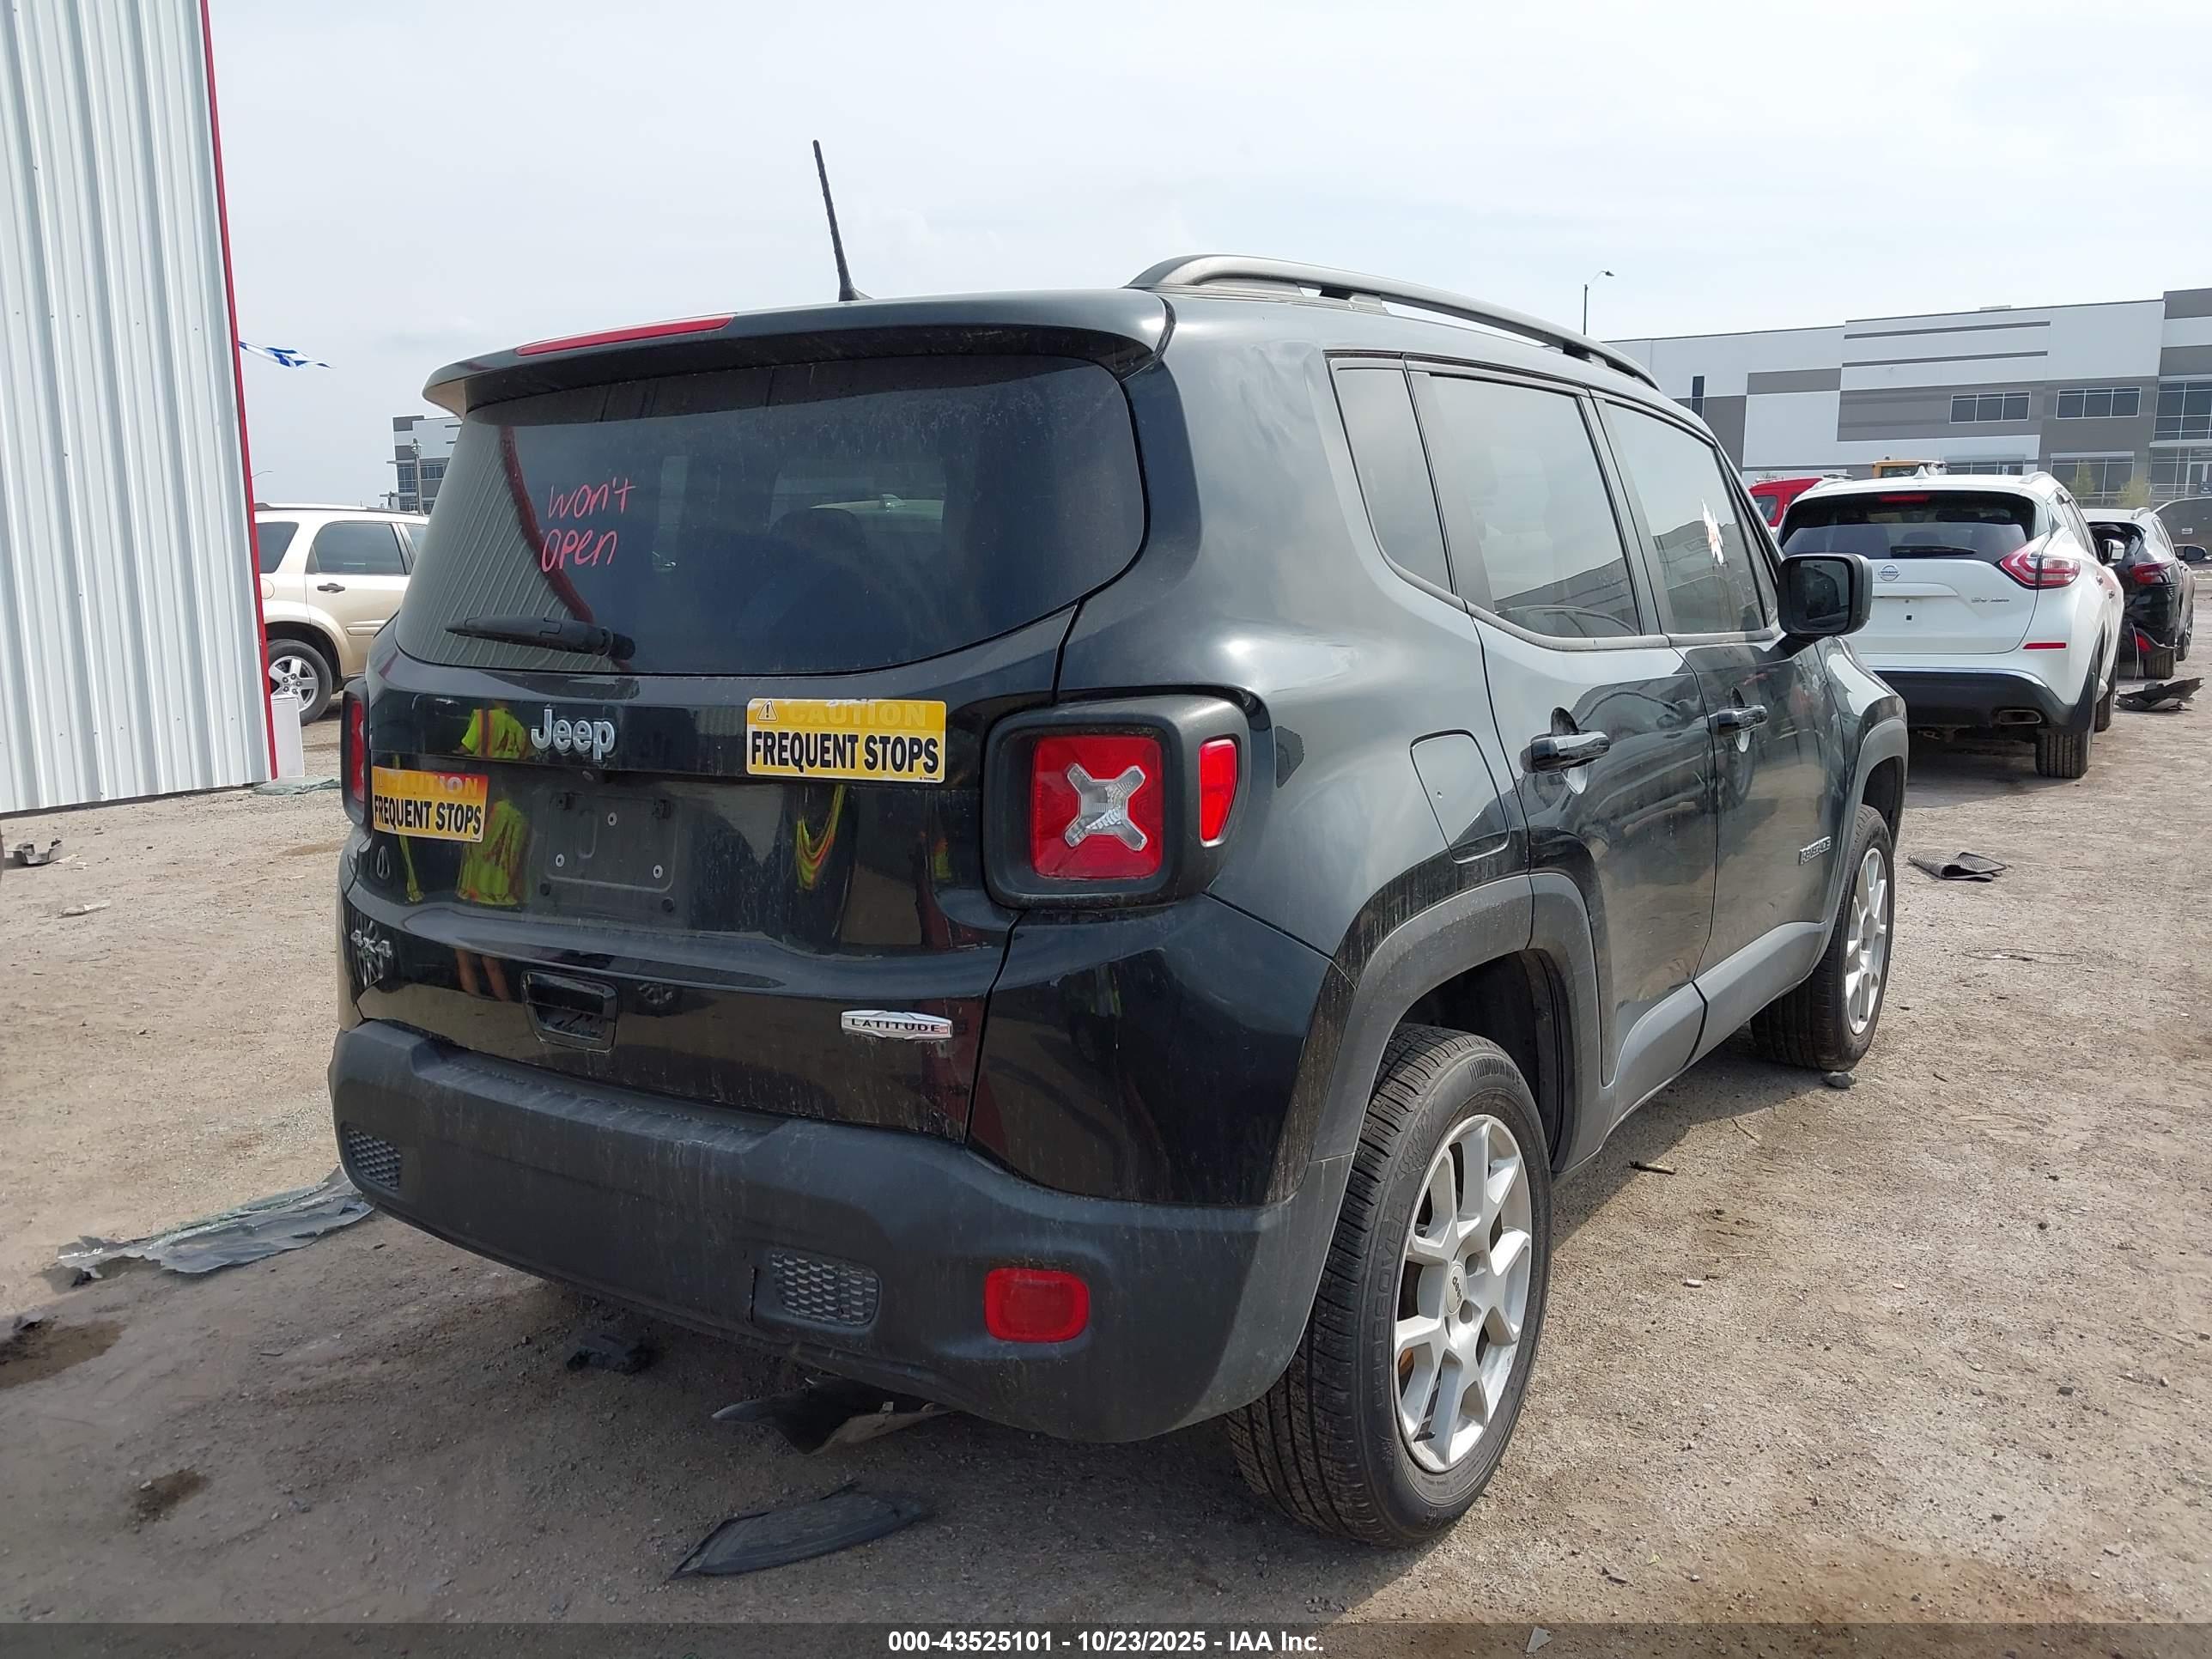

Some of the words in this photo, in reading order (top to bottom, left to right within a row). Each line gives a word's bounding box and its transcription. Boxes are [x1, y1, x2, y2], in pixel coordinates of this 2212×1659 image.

[531, 708, 615, 760] Jeep
[787, 702, 927, 727] CAUTION
[751, 731, 860, 773] FREQUENT
[864, 734, 939, 774] STOPS
[374, 794, 432, 830] FREQUENT
[434, 802, 482, 835] STOPS
[851, 1018, 941, 1032] LATITUDE
